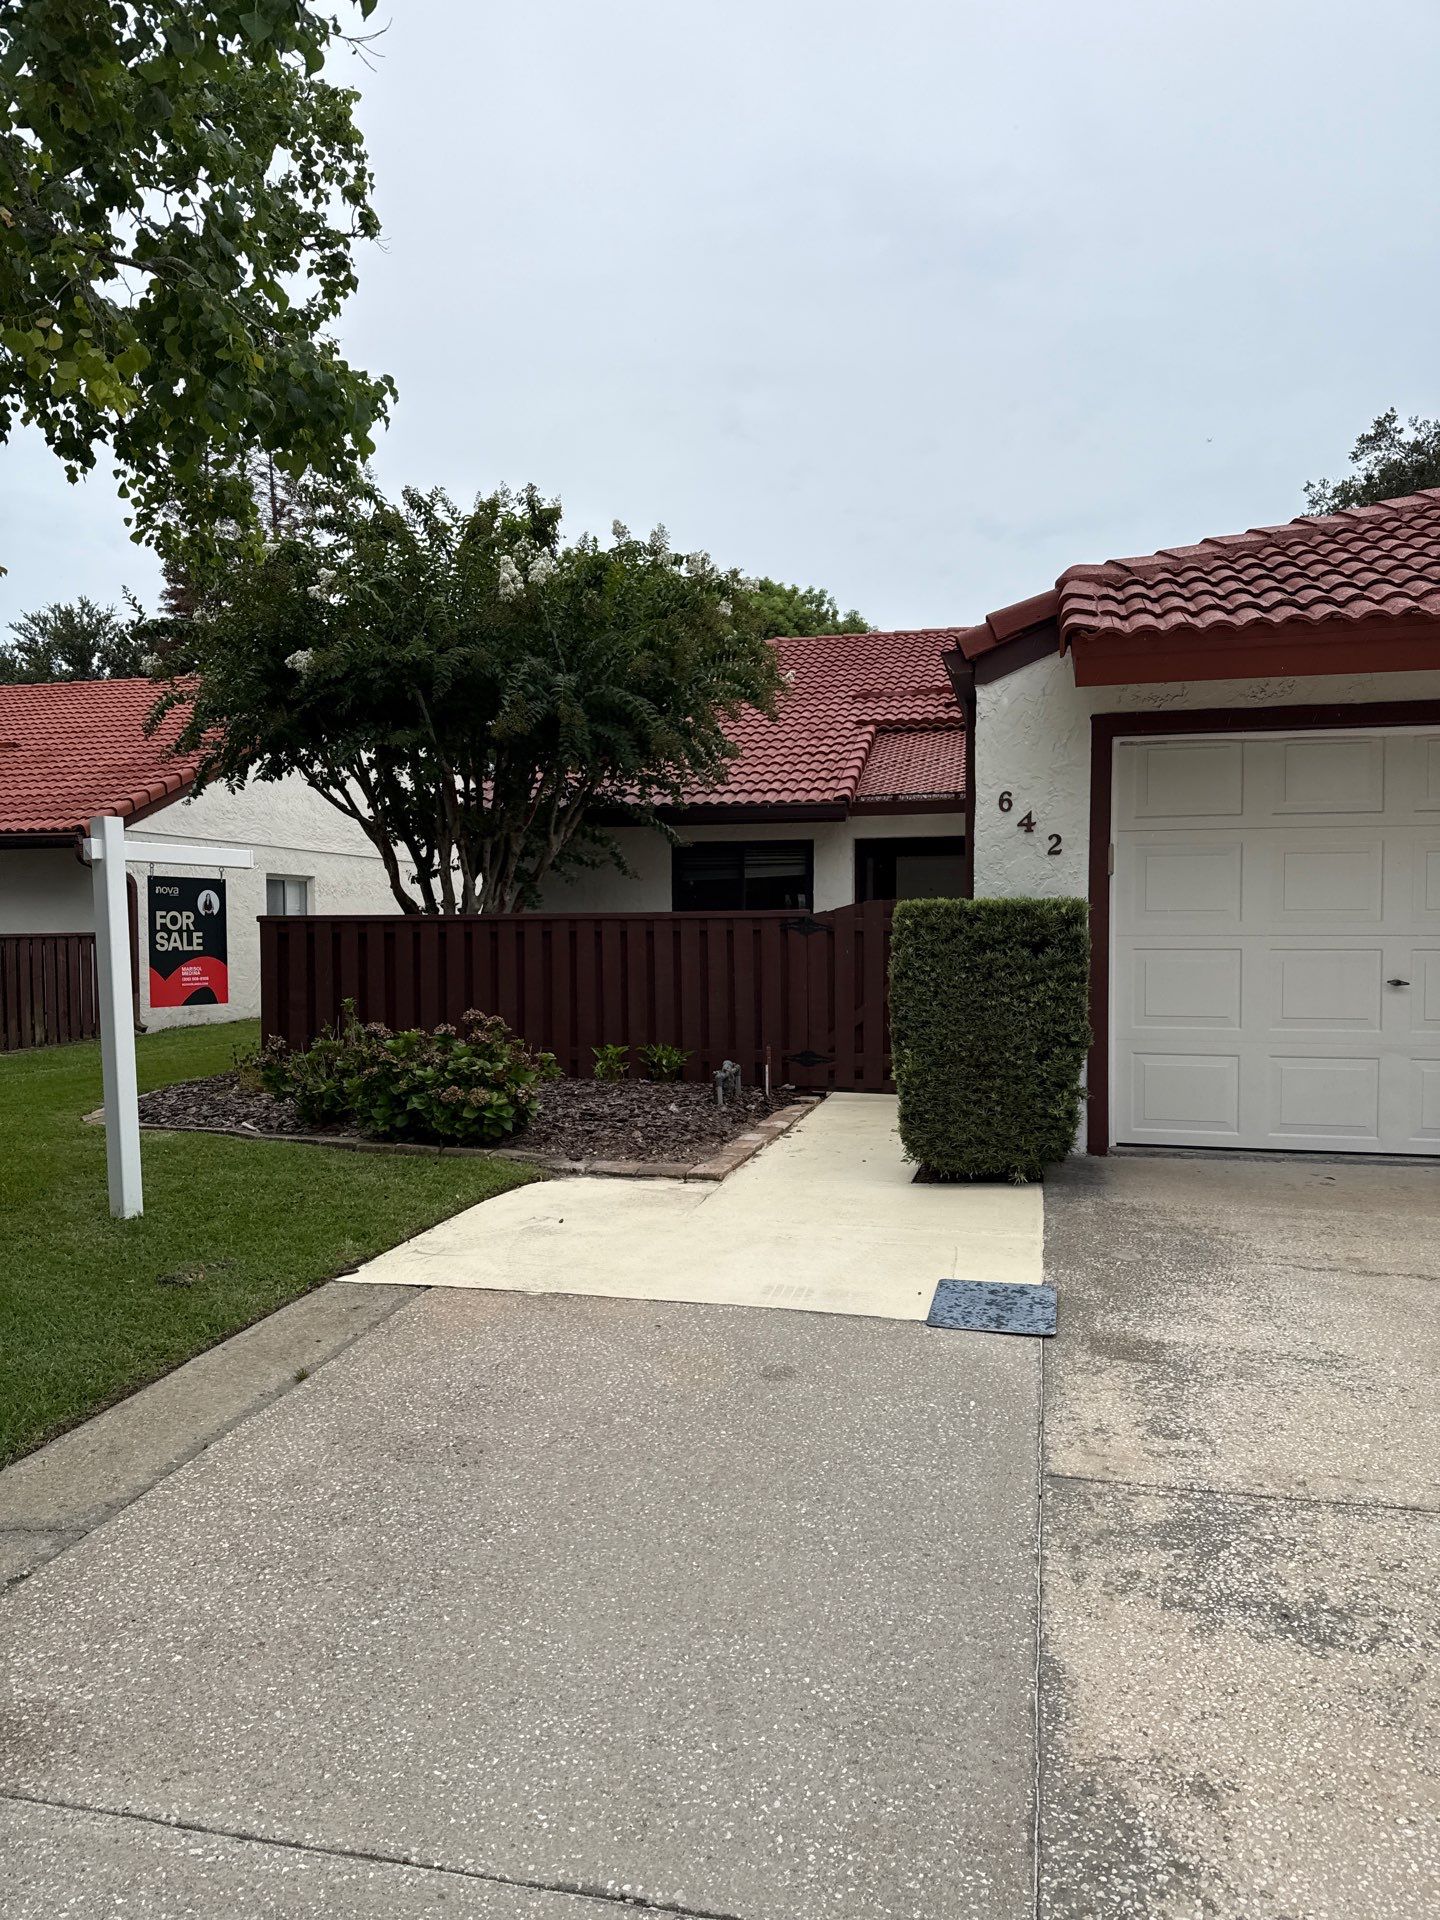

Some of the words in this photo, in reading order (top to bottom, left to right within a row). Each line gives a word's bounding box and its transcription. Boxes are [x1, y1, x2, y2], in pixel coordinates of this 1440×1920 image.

[155, 886, 179, 894] nova
[155, 911, 195, 930] FOR
[155, 931, 204, 951] SALE
